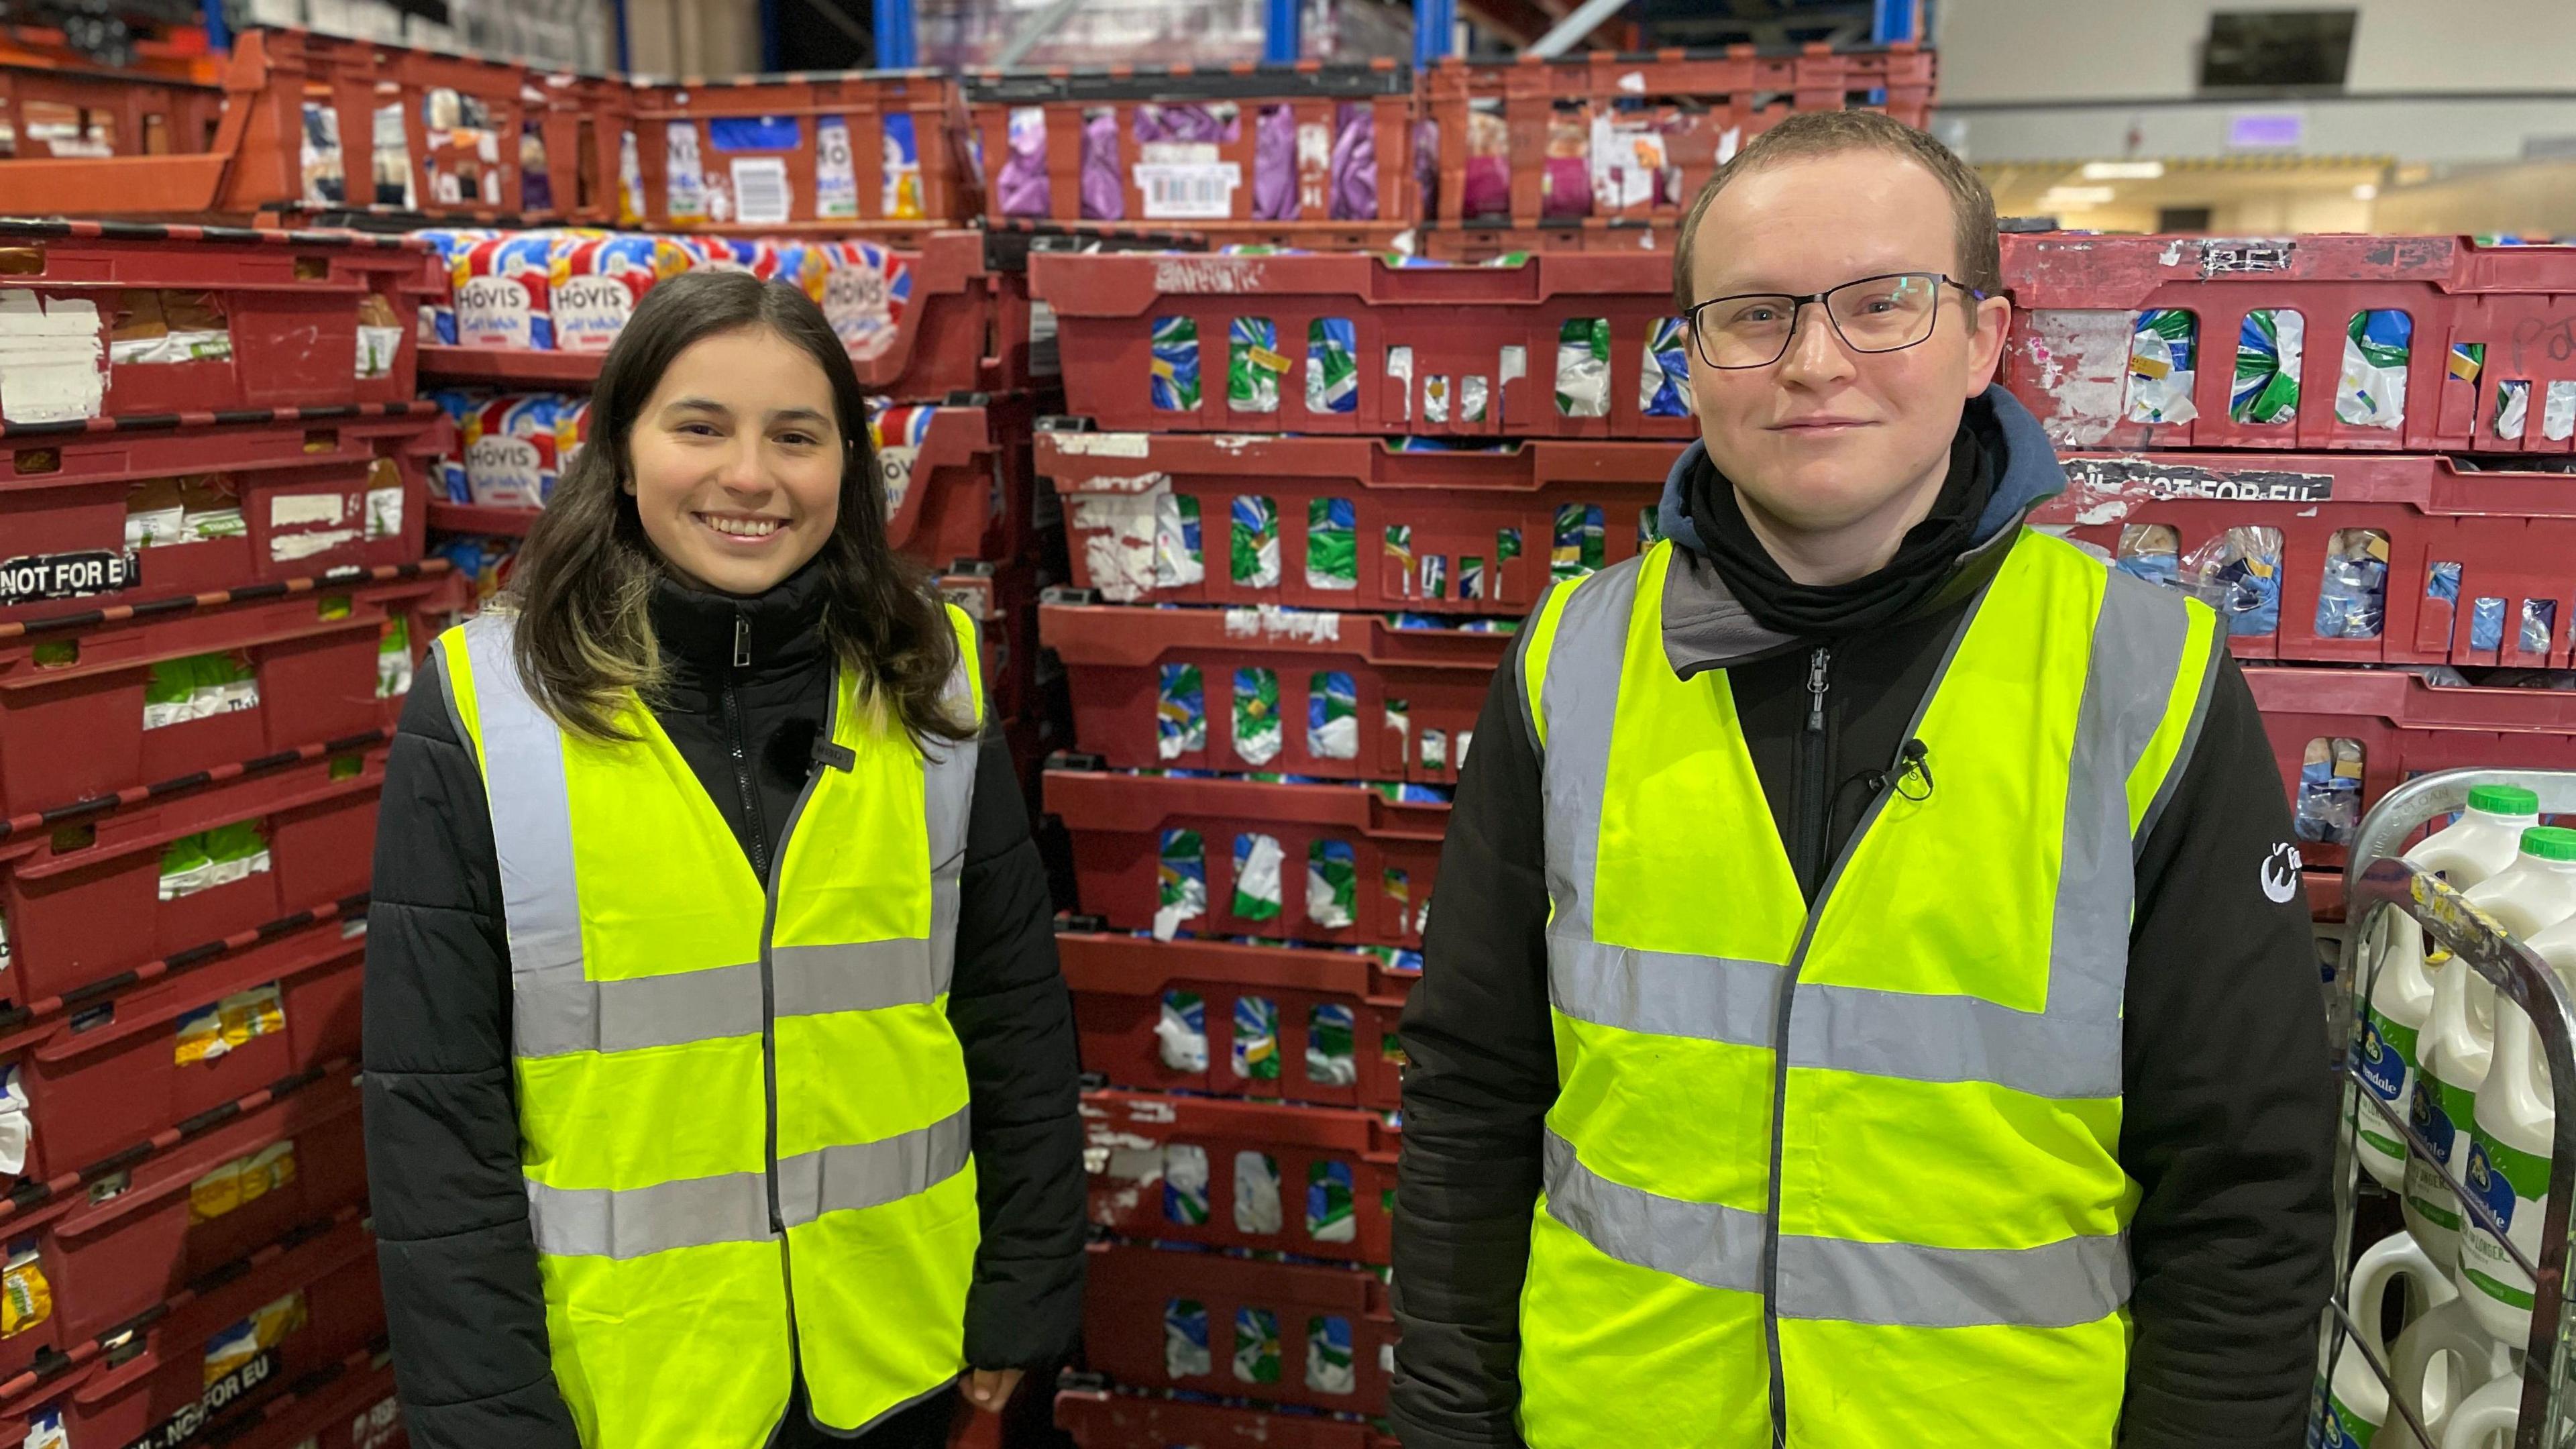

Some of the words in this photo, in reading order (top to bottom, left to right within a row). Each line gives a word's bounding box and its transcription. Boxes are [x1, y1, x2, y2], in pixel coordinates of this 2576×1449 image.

[0, 566, 50, 596] NOT
[55, 561, 102, 590] FOR
[243, 1355, 269, 1388] EU
